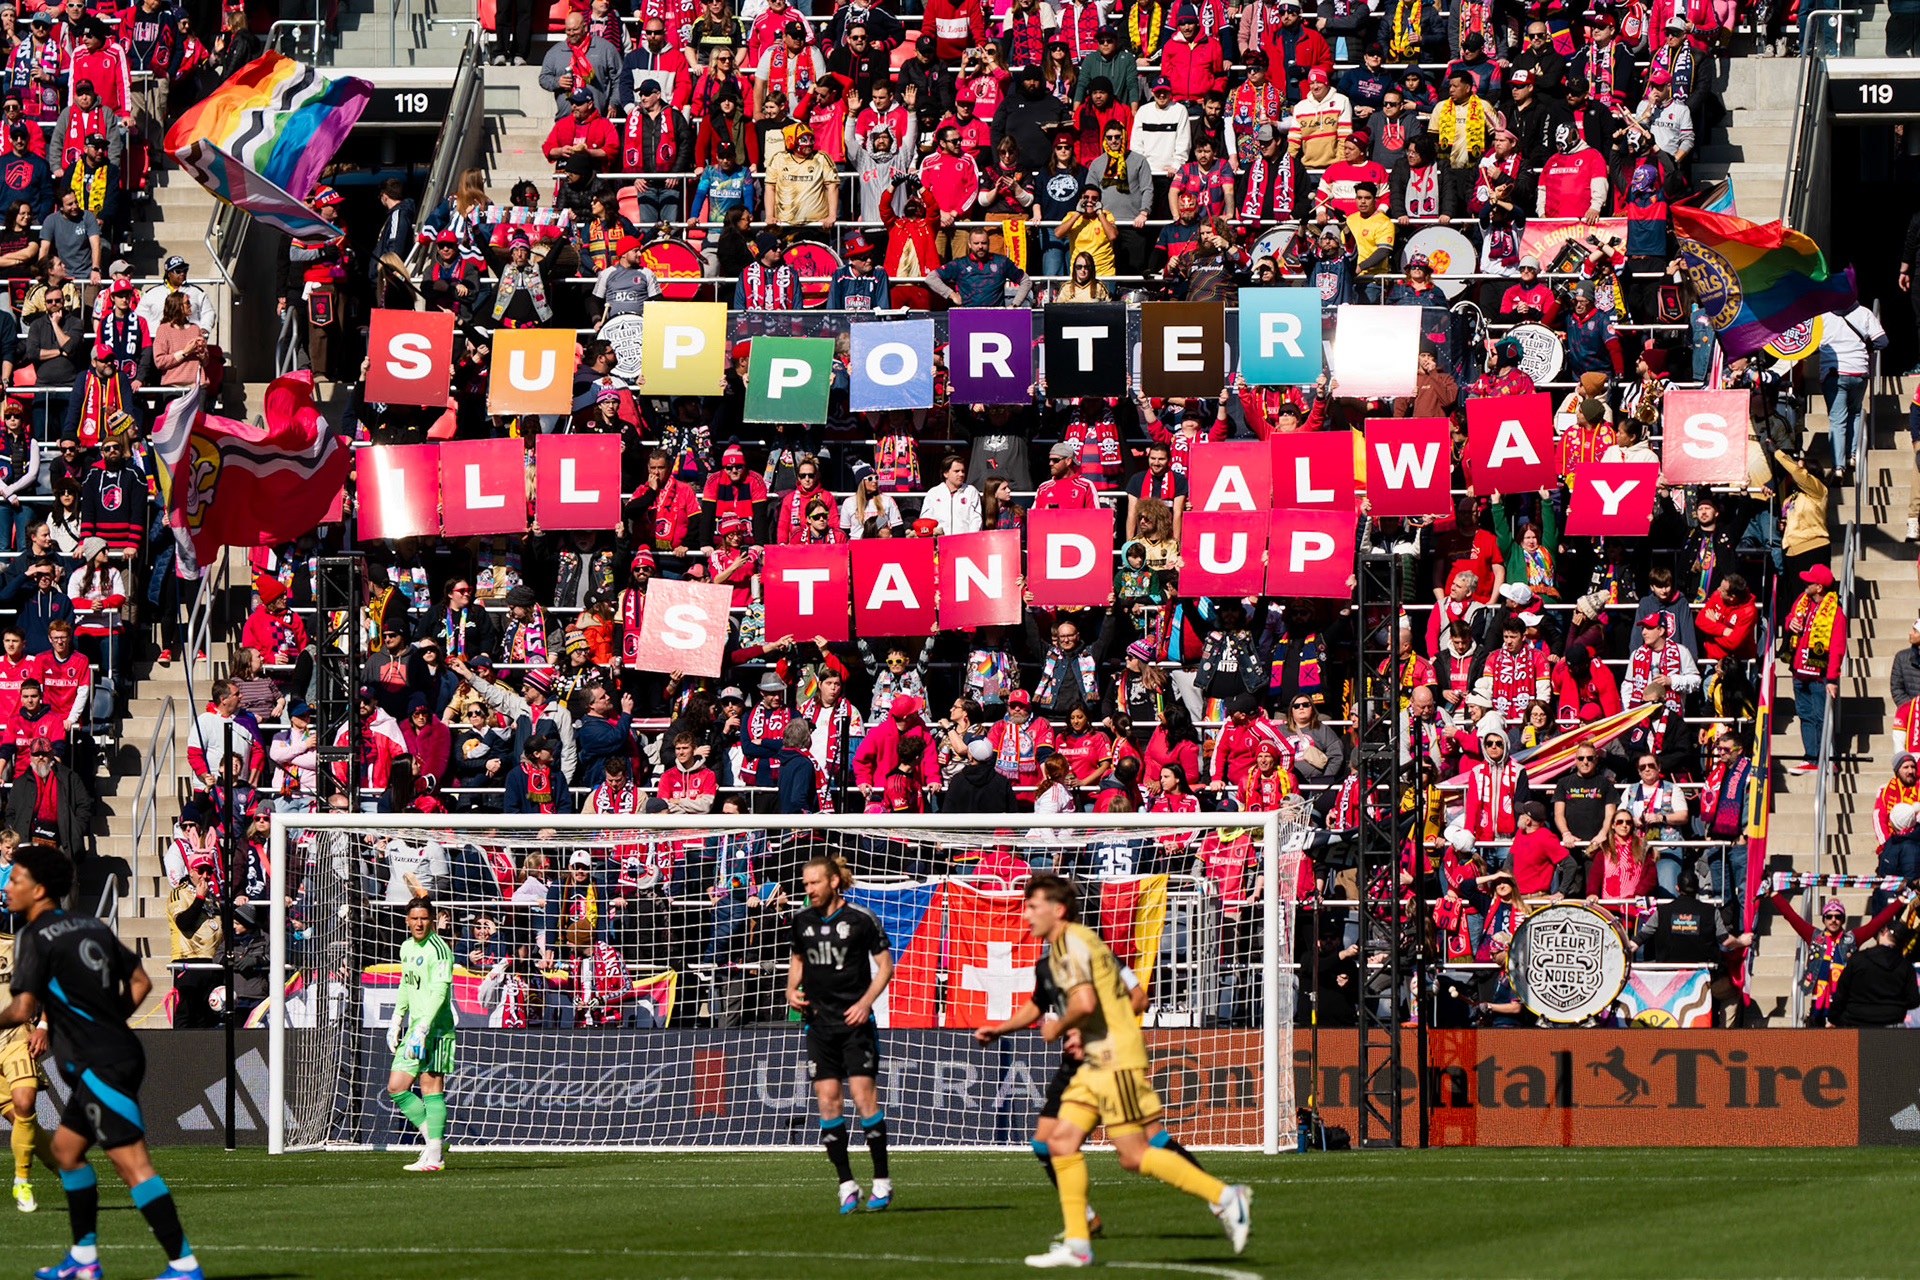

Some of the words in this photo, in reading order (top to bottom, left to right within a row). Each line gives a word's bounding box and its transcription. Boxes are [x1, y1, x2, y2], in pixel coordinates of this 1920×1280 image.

[948, 24, 969, 33] Loui
[394, 93, 429, 113] 119
[1858, 84, 1894, 104] 119
[613, 329, 637, 341] FLEUR
[621, 340, 633, 348] DE
[617, 347, 641, 358] NOISE
[50, 678, 78, 686] PURINA
[1099, 847, 1133, 875] 35
[1546, 936, 1586, 949] FLEUR
[79, 937, 110, 988] 9
[807, 941, 849, 970] ally
[1556, 953, 1575, 965] DE
[404, 970, 421, 990] ally
[1545, 969, 1585, 984] NOISE
[12, 1058, 29, 1077] 11
[440, 1061, 673, 1112] Michelob
[757, 1059, 1044, 1110] UTRA
[1651, 1048, 1848, 1109] Tire
[84, 1102, 107, 1141] 9
